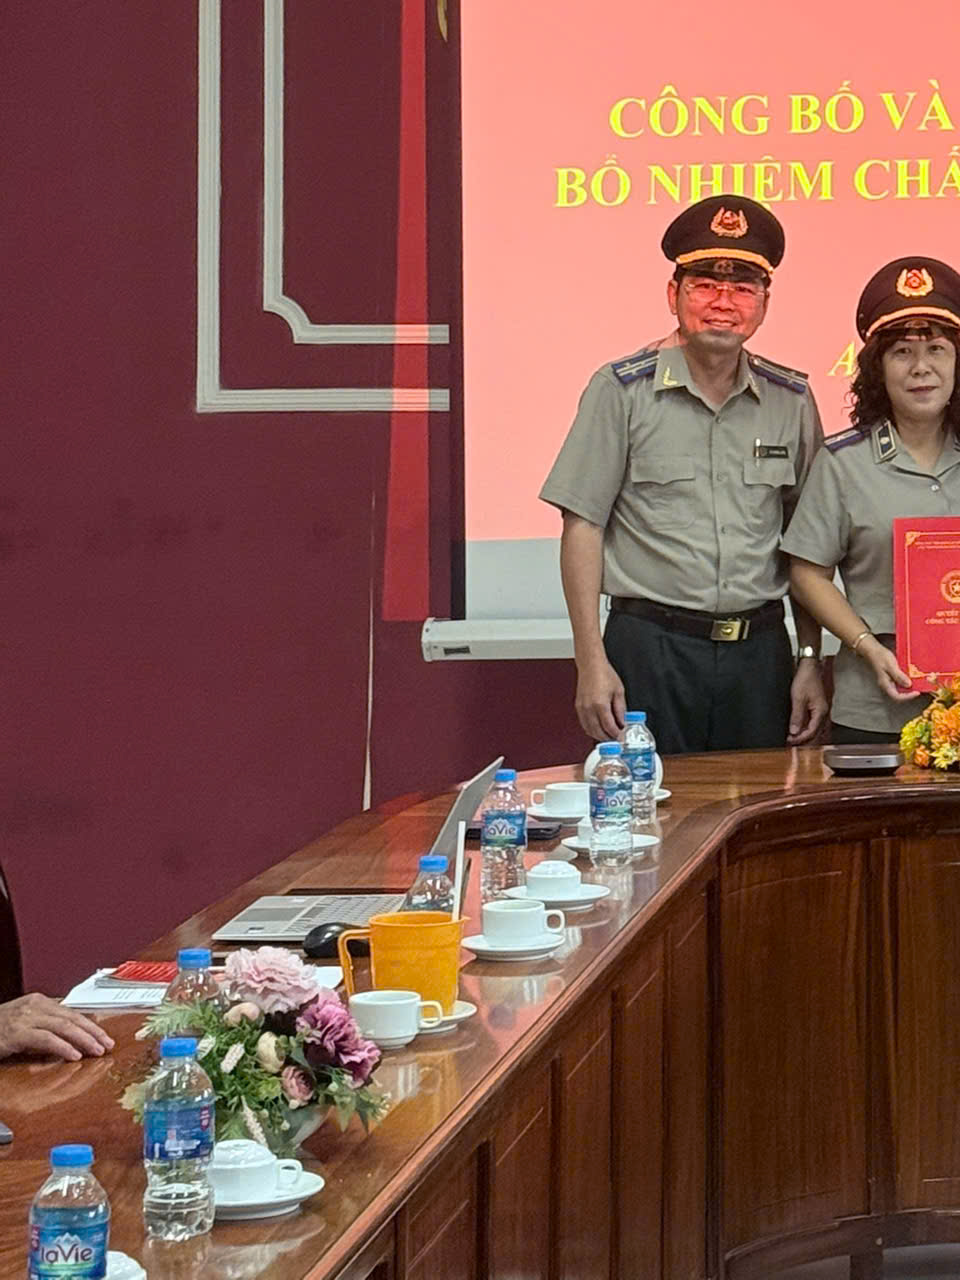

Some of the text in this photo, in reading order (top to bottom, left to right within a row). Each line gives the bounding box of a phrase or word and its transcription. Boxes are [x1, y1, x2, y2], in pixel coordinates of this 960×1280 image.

[608, 84, 771, 139] CÔNG
[787, 79, 866, 135] BỐ
[879, 79, 955, 132] VÀ
[554, 154, 632, 208] BỔ
[647, 154, 834, 210] NHIỆM
